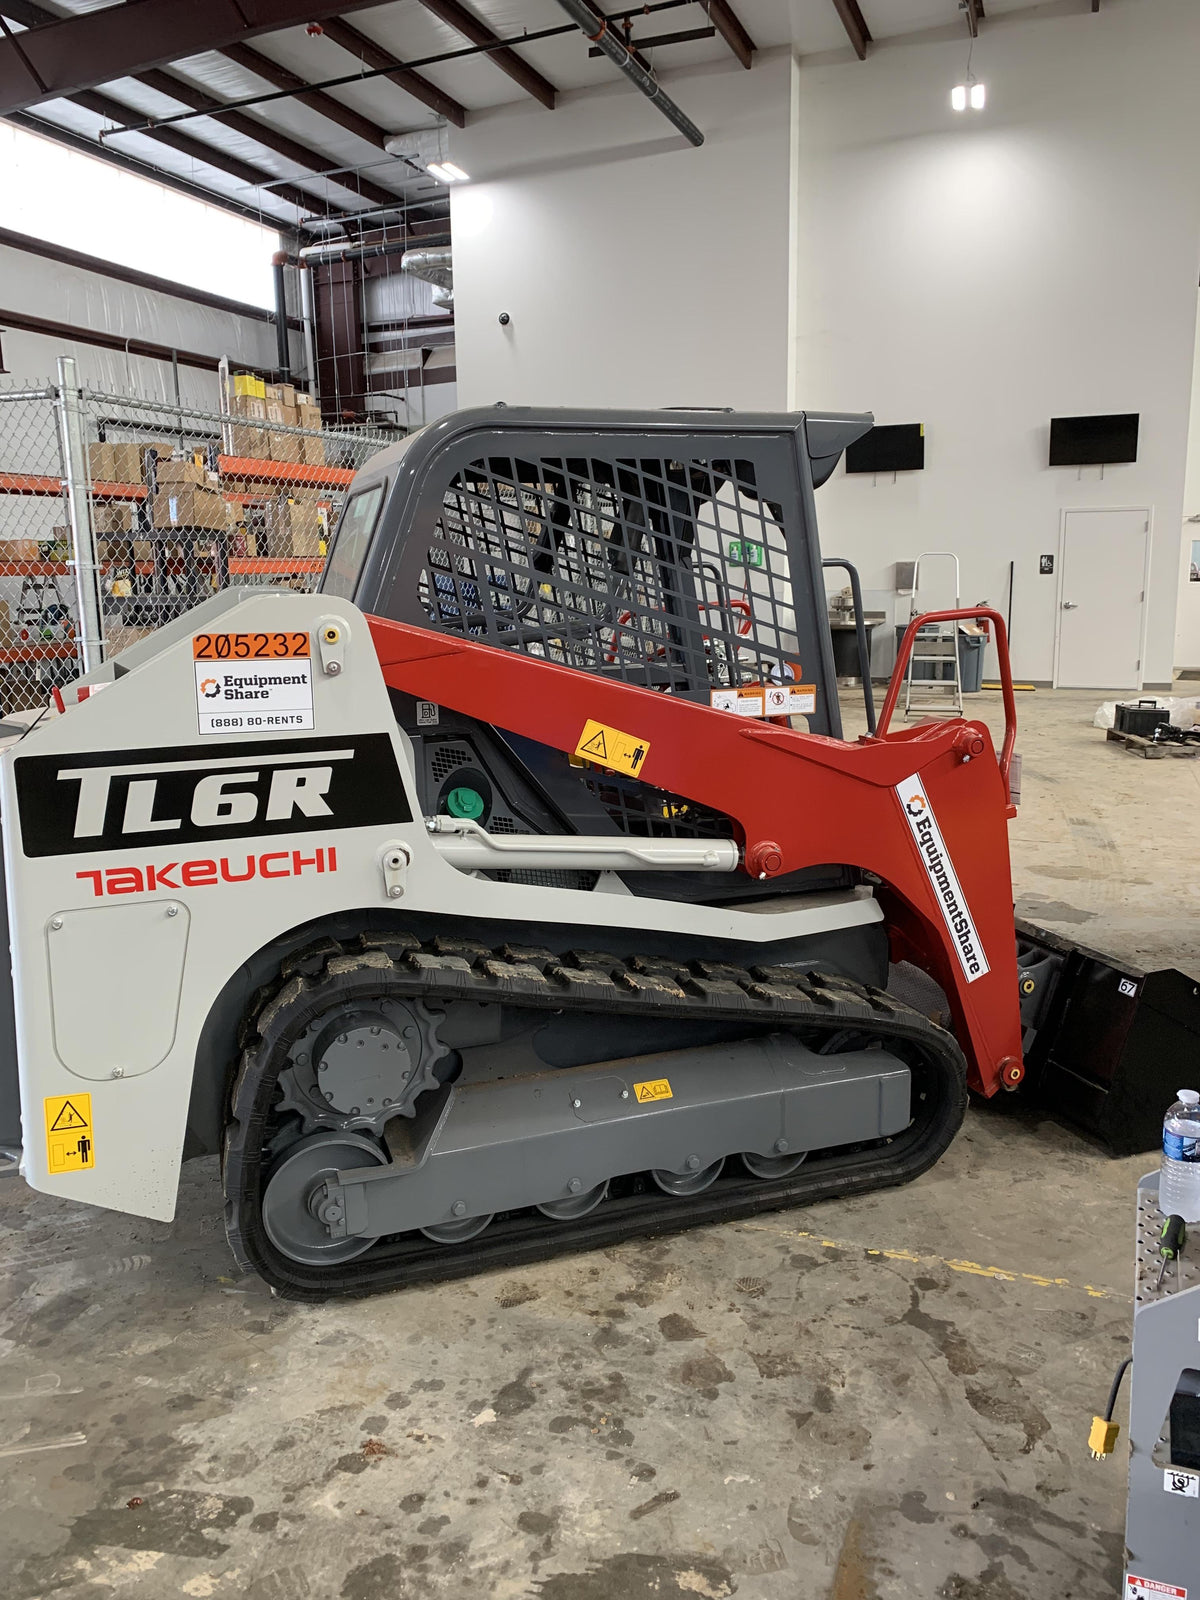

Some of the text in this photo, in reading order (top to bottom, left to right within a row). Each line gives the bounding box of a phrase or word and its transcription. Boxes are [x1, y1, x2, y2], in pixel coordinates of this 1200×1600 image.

[195, 633, 308, 658] 205232
[223, 674, 308, 688] Equipment
[224, 689, 270, 700] Share
[211, 715, 303, 728] (888) 80-RENTS
[57, 749, 355, 838] TL6R
[915, 815, 981, 976] EquipmentShare
[1120, 981, 1136, 994] 67
[1143, 1580, 1177, 1596] DANGER
